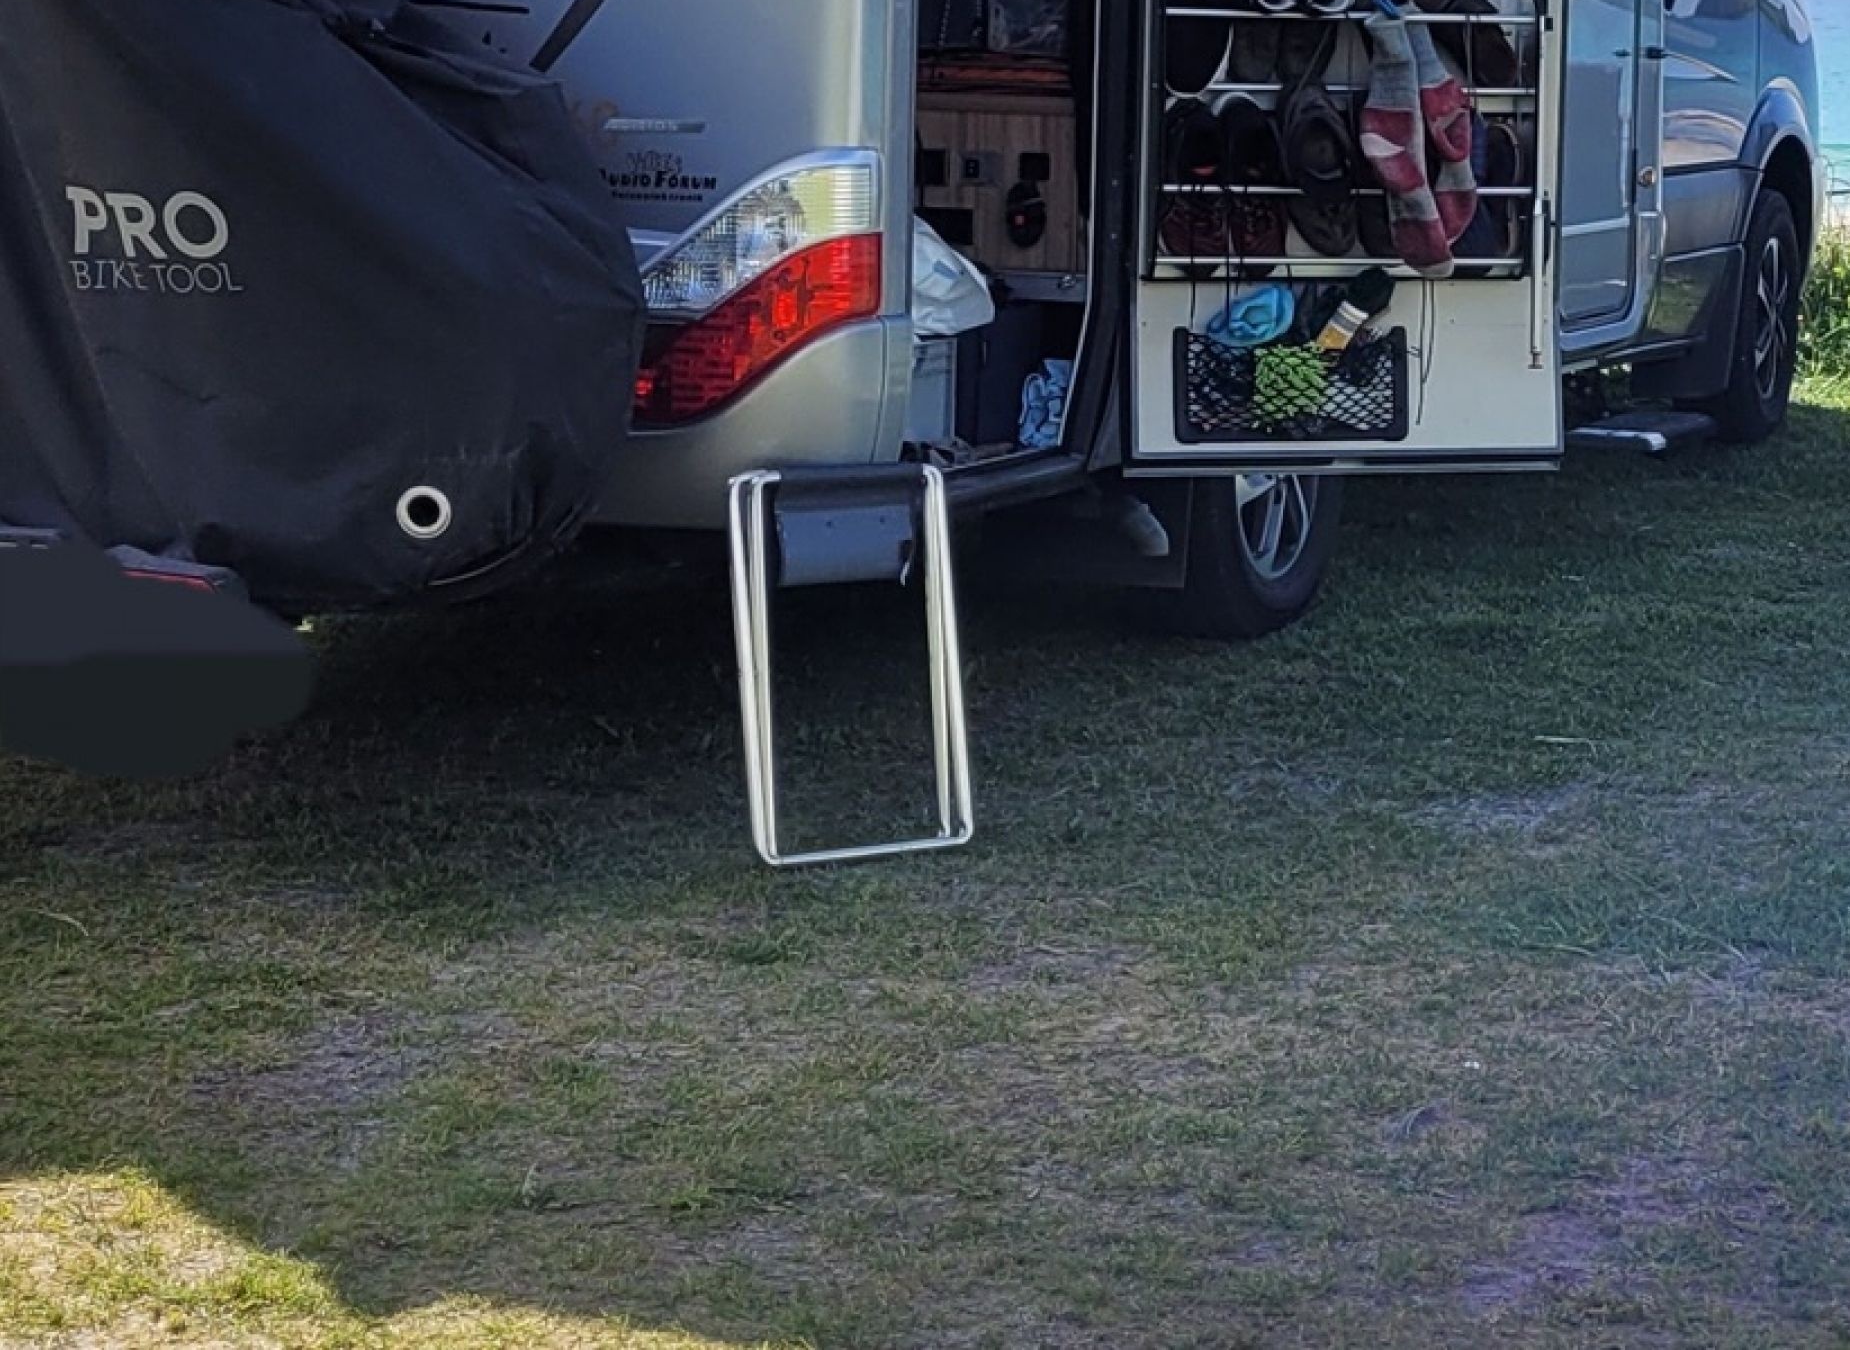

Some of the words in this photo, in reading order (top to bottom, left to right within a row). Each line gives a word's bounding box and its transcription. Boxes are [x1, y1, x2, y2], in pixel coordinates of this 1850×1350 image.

[65, 185, 229, 260] PRO
[69, 260, 150, 291] BIKE
[149, 261, 245, 294] TOOL
